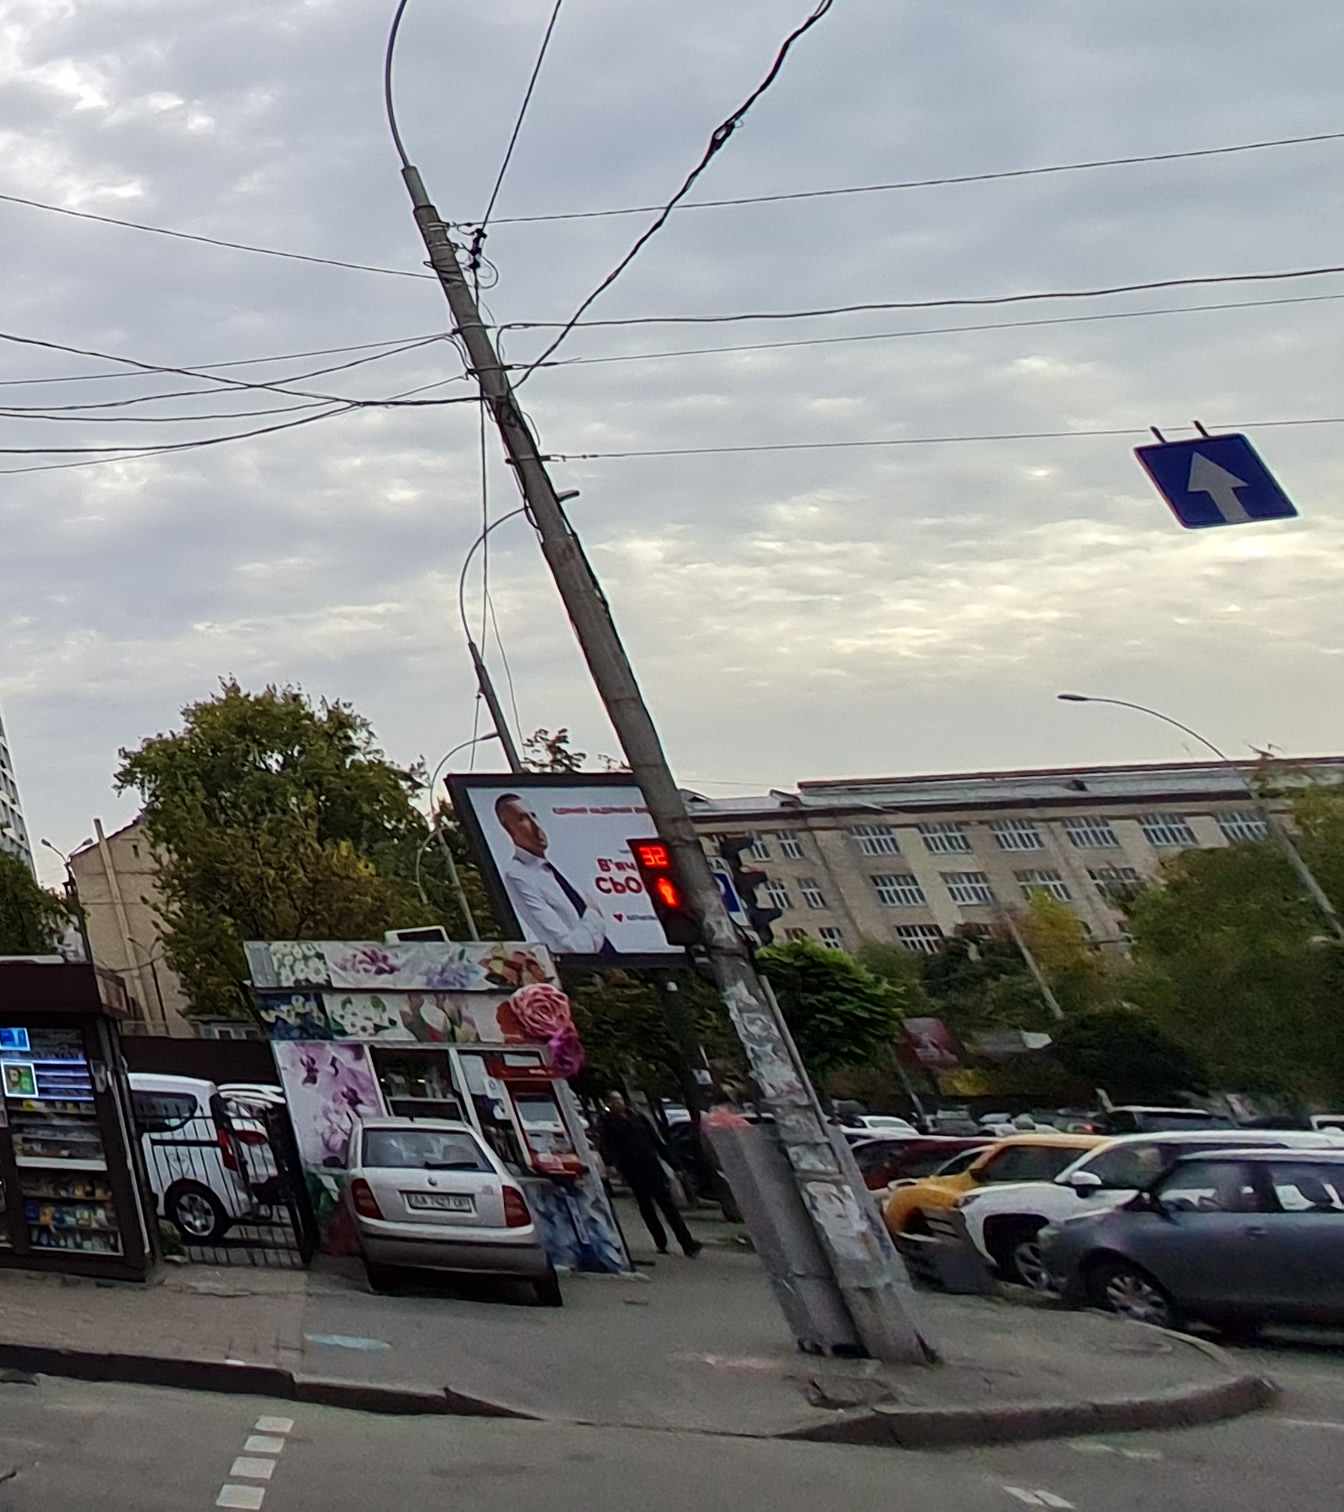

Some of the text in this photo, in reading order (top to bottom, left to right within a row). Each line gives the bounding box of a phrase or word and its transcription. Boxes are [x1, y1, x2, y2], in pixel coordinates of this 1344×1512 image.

[639, 846, 668, 865] 32
[597, 858, 637, 872] В'яч
[595, 876, 643, 894] СЬО
